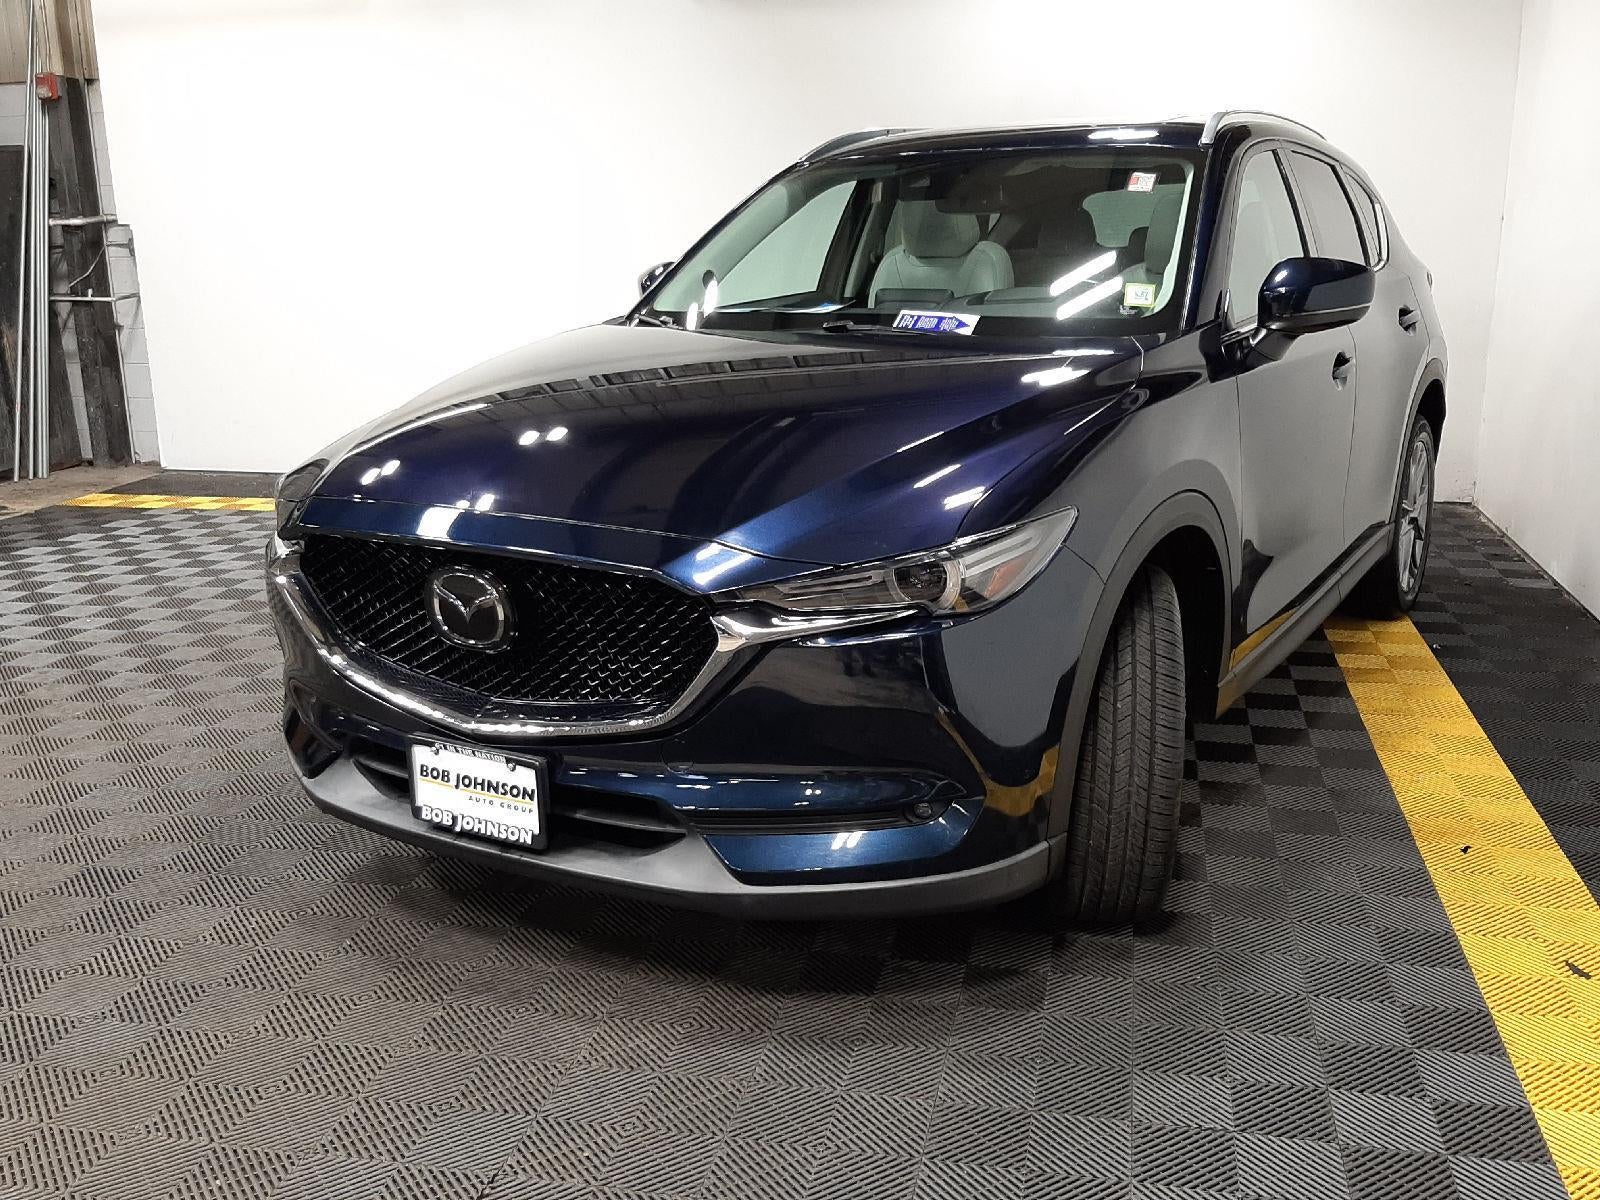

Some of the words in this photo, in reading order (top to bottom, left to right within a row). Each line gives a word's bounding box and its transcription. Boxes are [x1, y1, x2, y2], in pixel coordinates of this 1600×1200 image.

[419, 764, 451, 784] BOB
[454, 773, 536, 802] JOHNSON
[468, 795, 494, 806] AUTO
[500, 802, 534, 814] GROUP
[421, 804, 454, 826] BOB
[454, 813, 534, 845] JOHNSON
